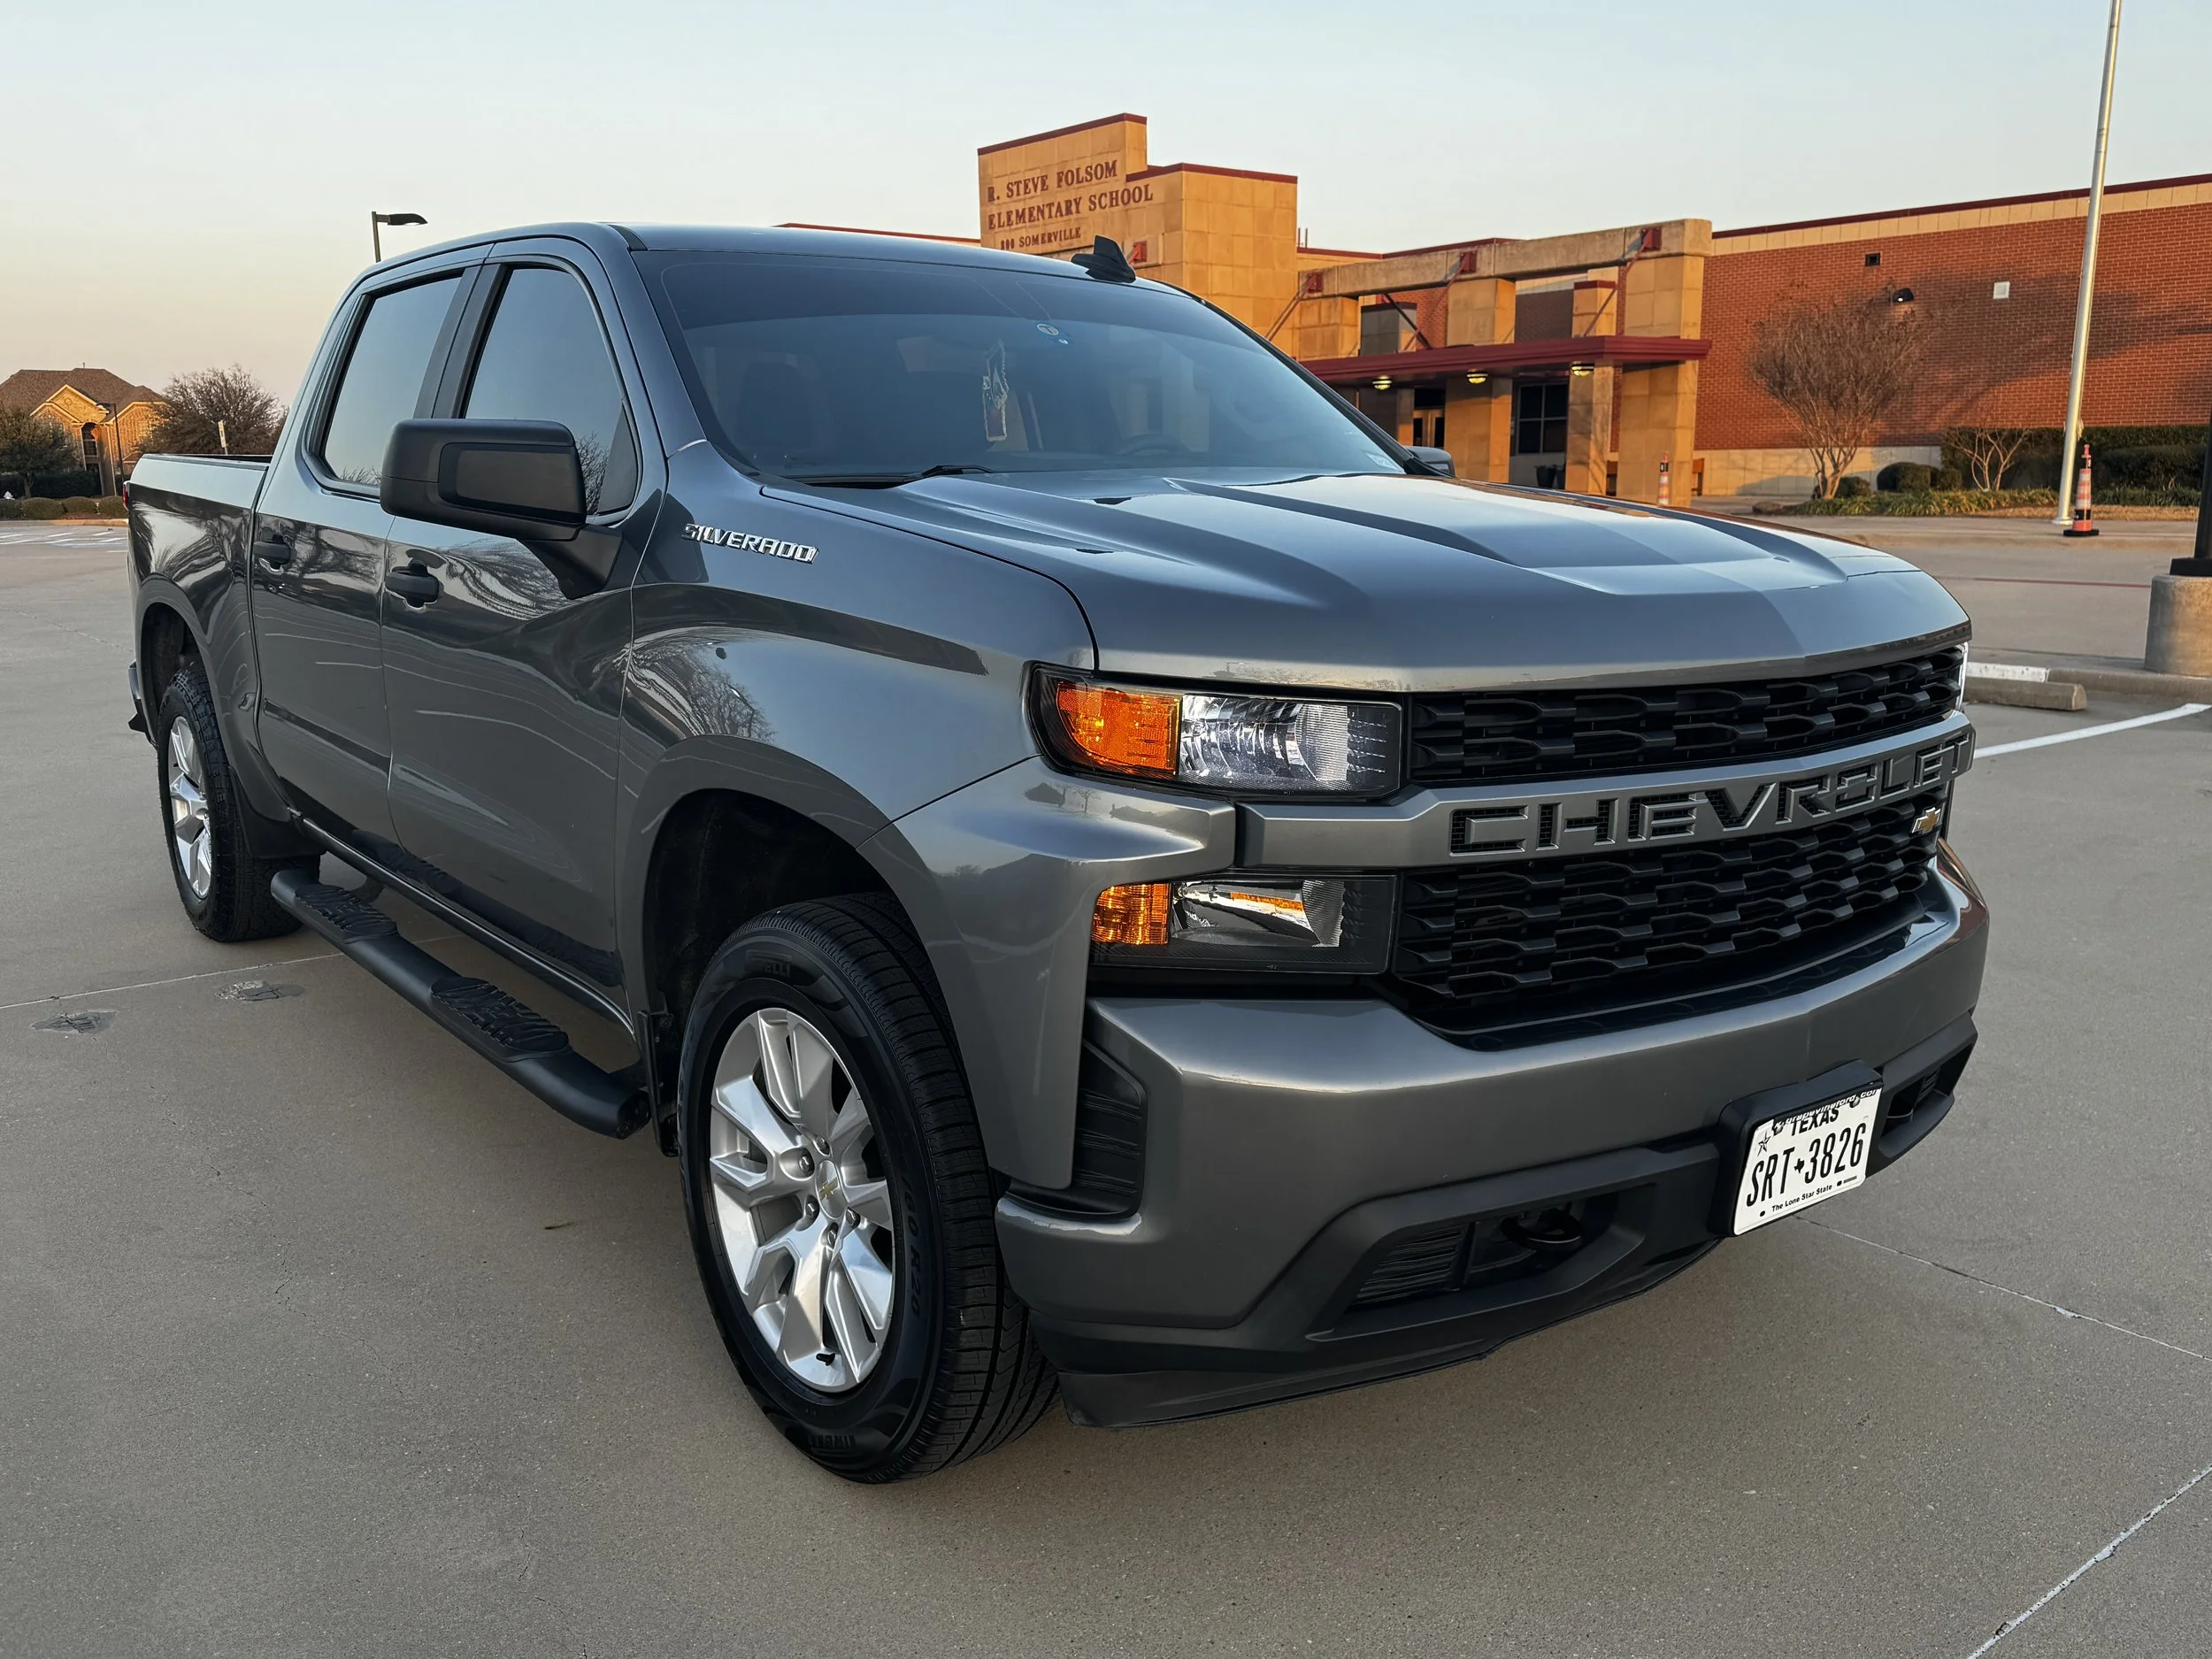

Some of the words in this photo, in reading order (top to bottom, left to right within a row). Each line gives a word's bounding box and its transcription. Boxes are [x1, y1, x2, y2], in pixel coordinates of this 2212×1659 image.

[987, 186, 1001, 203] R.
[1006, 174, 1048, 198] STEVE
[1056, 159, 1118, 188] FOLSOM
[987, 196, 1083, 230] ELEMENTARY
[1088, 183, 1153, 211] SCHOOL
[1019, 227, 1081, 248] SOMERVILLE
[680, 523, 820, 565] SILVERADO
[1449, 733, 1970, 856] CHEVROLET
[1791, 1107, 1839, 1136] TEXAS
[1746, 1147, 1795, 1208] SRT
[1804, 1122, 1867, 1185] 3826
[1771, 1202, 1784, 1212] The
[1785, 1196, 1801, 1207] Lone
[1801, 1192, 1815, 1201] Star
[1816, 1185, 1832, 1195] State
